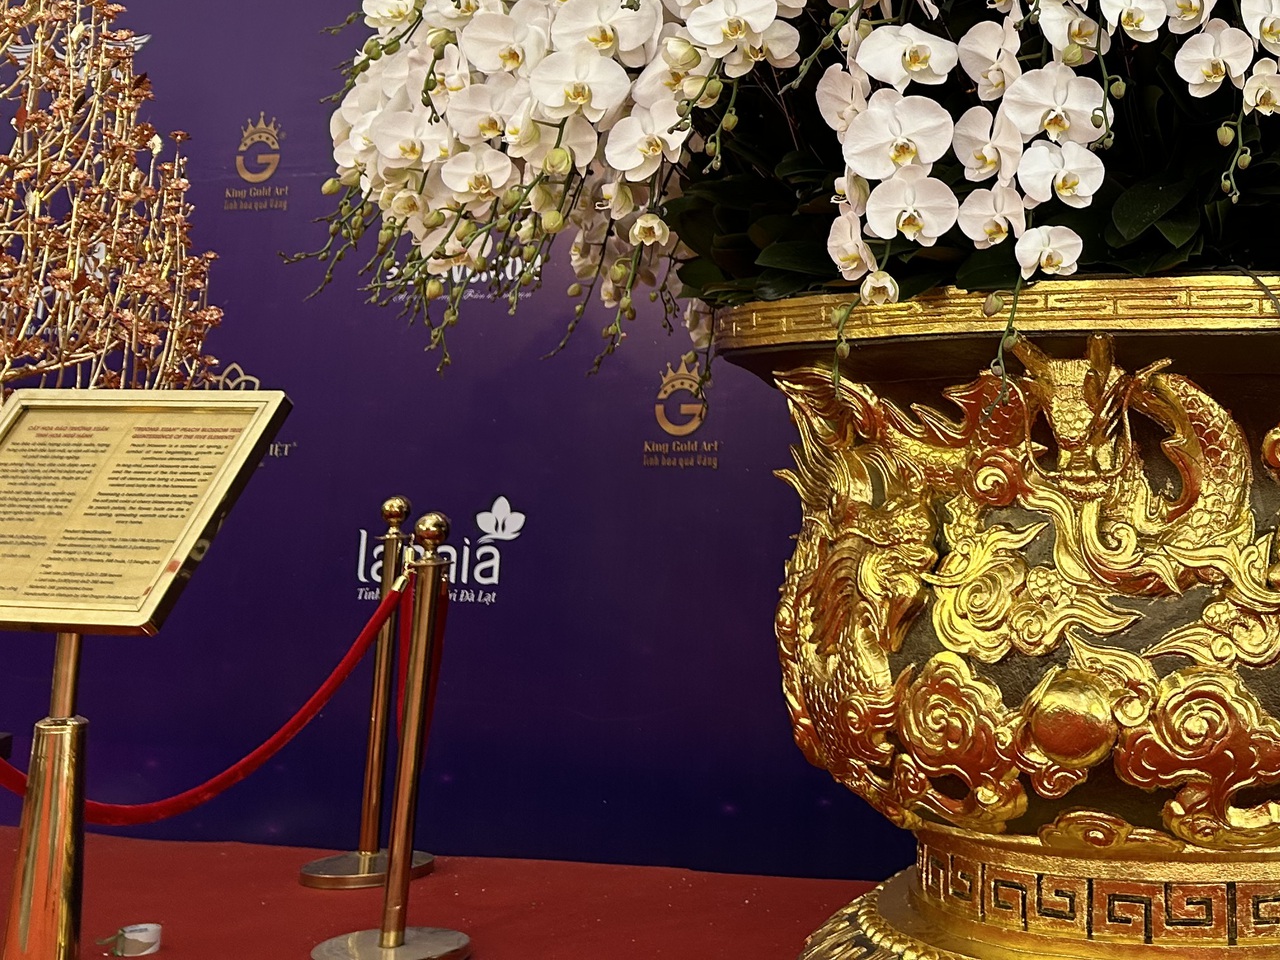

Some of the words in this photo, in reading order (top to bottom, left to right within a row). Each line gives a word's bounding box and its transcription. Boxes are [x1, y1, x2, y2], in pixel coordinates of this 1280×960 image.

[225, 187, 247, 199] King
[249, 186, 271, 197] Gold
[275, 185, 288, 196] Art
[269, 441, 292, 458] IỆT
[644, 440, 669, 454] King
[672, 440, 698, 452] Gold
[702, 440, 718, 452] Art
[477, 589, 497, 605] Lạt
